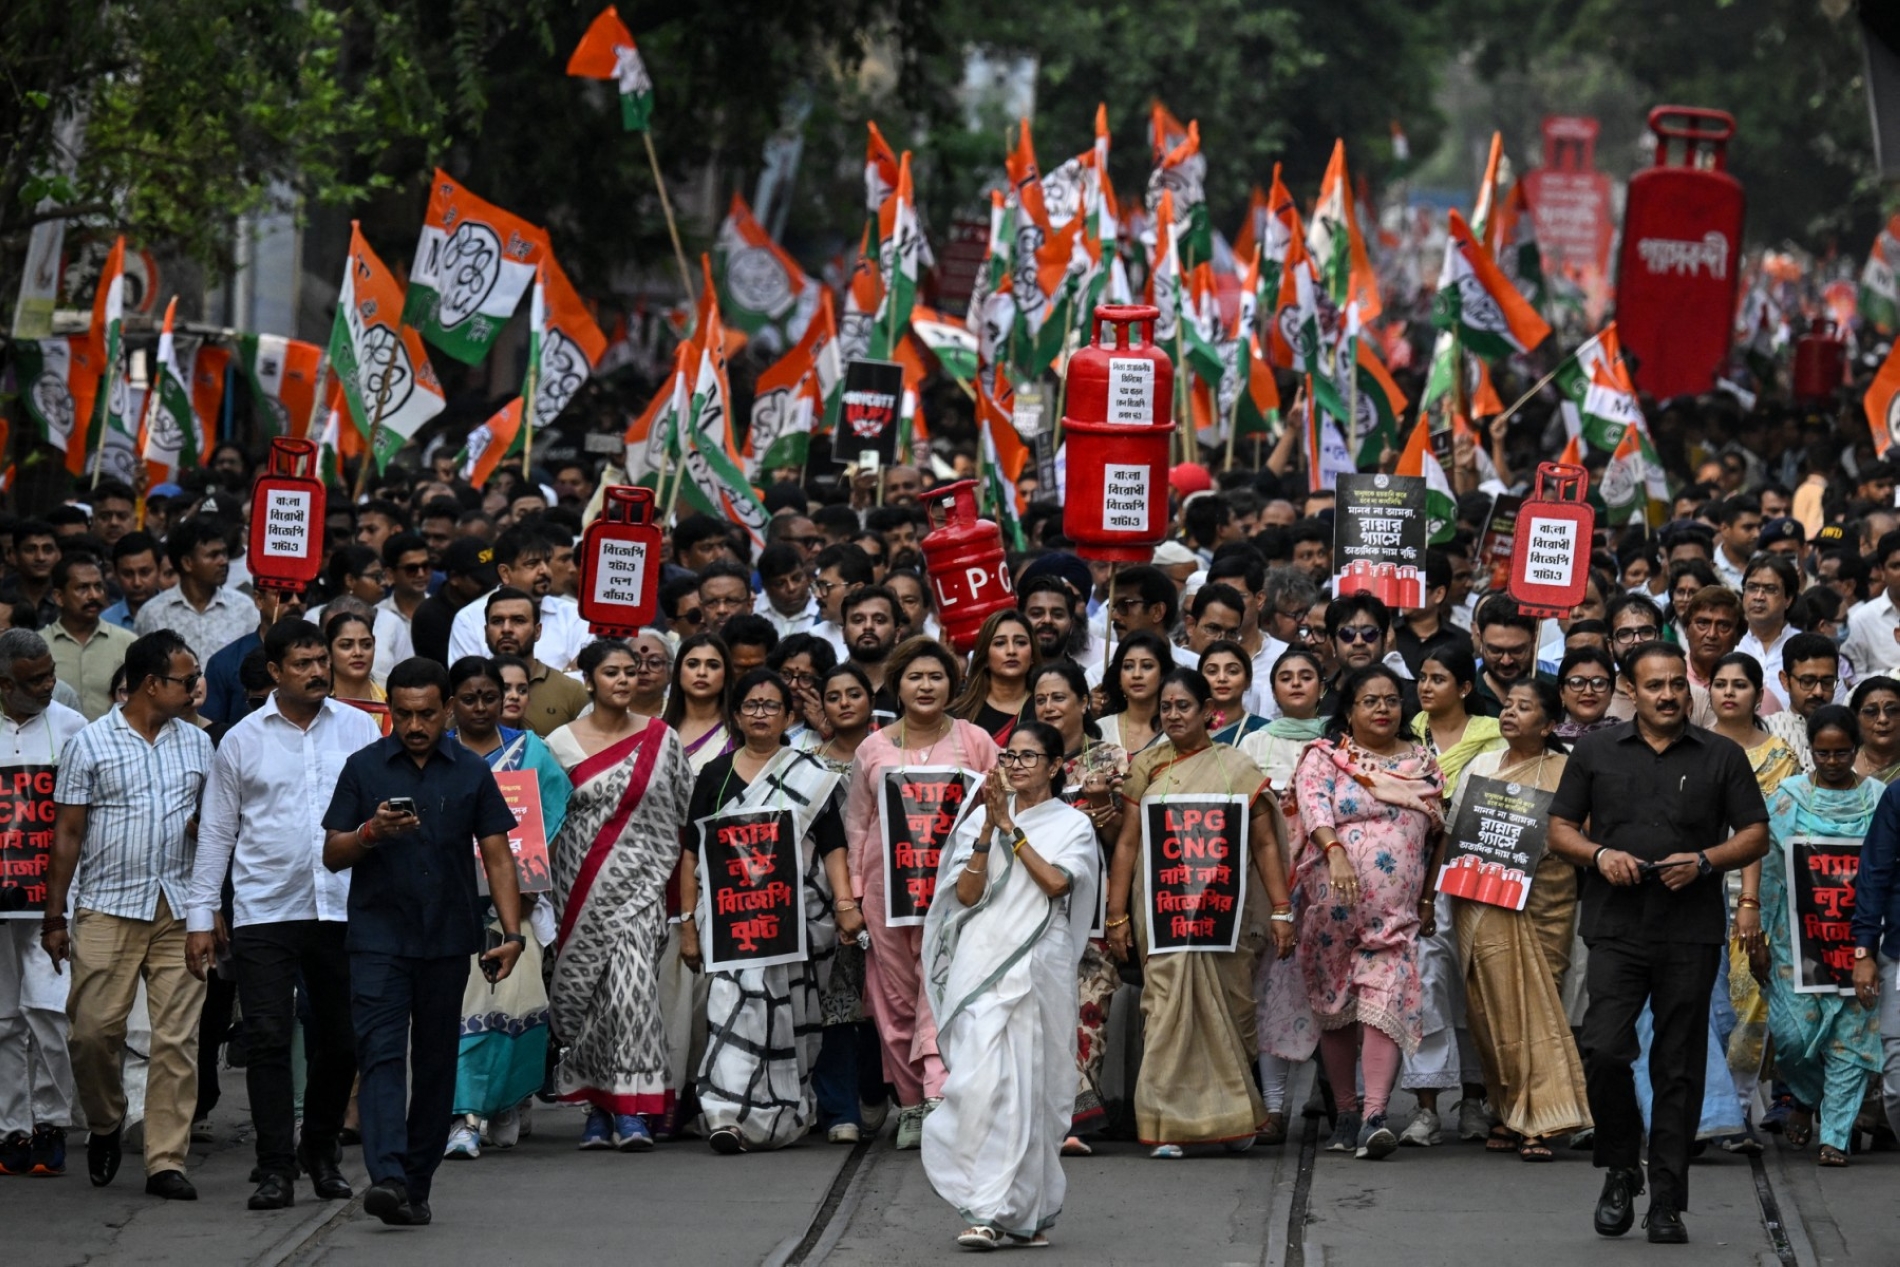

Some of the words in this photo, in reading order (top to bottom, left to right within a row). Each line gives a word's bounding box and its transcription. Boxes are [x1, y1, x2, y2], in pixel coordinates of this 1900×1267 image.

[1114, 471, 1140, 481] বাংলা
[1108, 484, 1144, 497] বিরোধী
[276, 497, 300, 506] বাংলা
[1107, 500, 1144, 512] বিজেপি
[270, 509, 304, 522] বিরোধী
[1348, 506, 1370, 515] মানব
[268, 524, 305, 537] বিজেপি
[1358, 518, 1403, 532] রান্নার
[1540, 525, 1566, 535] বাংলা
[271, 540, 299, 551] হাটাও
[1360, 532, 1401, 546] গ্যাসে
[1533, 537, 1570, 550] বিরোধী
[603, 543, 645, 558] বিজেপি
[1344, 545, 1379, 556] অত্যধিক
[1382, 548, 1397, 556] দাম
[1400, 546, 1417, 559] বৃদ্ধি
[1530, 551, 1569, 565] বিজেপি
[608, 560, 635, 572] হটাও
[1533, 568, 1562, 580] হাটাও
[610, 577, 632, 586] দেশ
[603, 589, 634, 601] বাঁচাও
[902, 782, 964, 804] গ্যাস
[1473, 805, 1496, 816] মানব
[1497, 810, 1506, 819] না
[1165, 809, 1226, 831] LPG
[718, 822, 780, 847] গ্যাস
[1480, 817, 1524, 838] রান্নার
[1478, 830, 1518, 850] গ্যাসে
[1163, 837, 1229, 860] CNG
[1459, 841, 1492, 854] অত্যধিক
[1494, 848, 1510, 859] দাম
[1512, 852, 1530, 865] বৃদ্ধি
[1159, 863, 1193, 885] নাই
[1196, 863, 1232, 885] নাই
[716, 881, 792, 915] বিজেপি
[1156, 889, 1234, 914] বিজেপির
[1171, 915, 1216, 938] বিদাই
